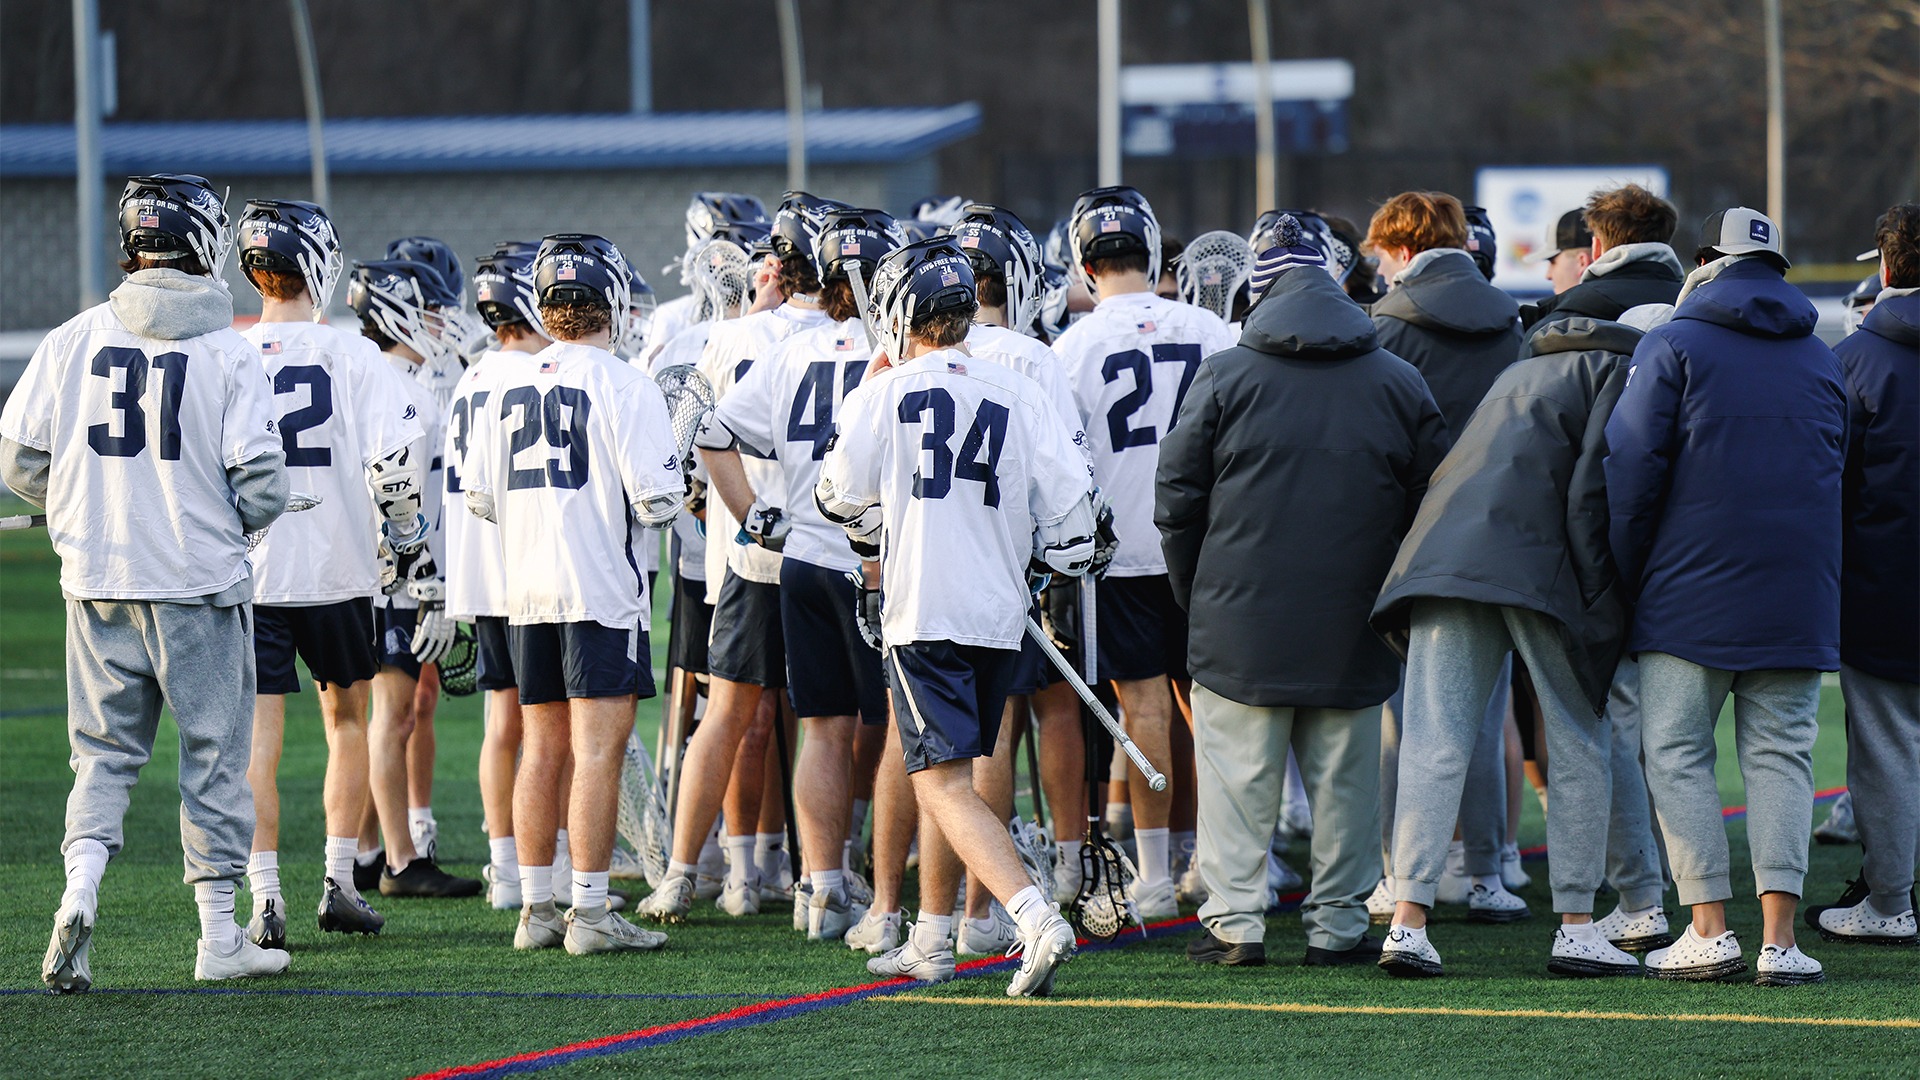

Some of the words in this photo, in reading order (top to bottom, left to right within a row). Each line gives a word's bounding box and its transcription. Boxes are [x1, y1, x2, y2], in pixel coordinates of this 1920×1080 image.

[139, 198, 155, 206] FREE
[156, 200, 166, 208] OR
[167, 202, 179, 212] DIE
[144, 206, 154, 215] 31
[1097, 205, 1113, 214] FREE
[1124, 206, 1135, 215] DIE
[1103, 211, 1116, 221] 27
[252, 220, 268, 228] FREE
[268, 221, 278, 230] OR
[277, 224, 289, 234] DIE
[256, 226, 267, 236] 32
[967, 228, 980, 237] 55
[982, 223, 992, 232] OR
[991, 227, 1003, 239] DIE
[839, 228, 856, 236] FREE
[856, 228, 866, 236] OR
[866, 230, 878, 240] DIE
[845, 235, 857, 244] 45
[555, 254, 572, 262] FREE
[572, 254, 583, 262] OR
[583, 257, 595, 267] DIE
[562, 260, 573, 269] 29
[933, 257, 950, 267] FREE
[941, 265, 953, 275] 34
[88, 346, 189, 461] 31
[1101, 343, 1202, 453] 27
[266, 365, 333, 467] 2
[500, 385, 592, 491] 29
[898, 388, 1010, 511] 34
[382, 477, 412, 493] STX
